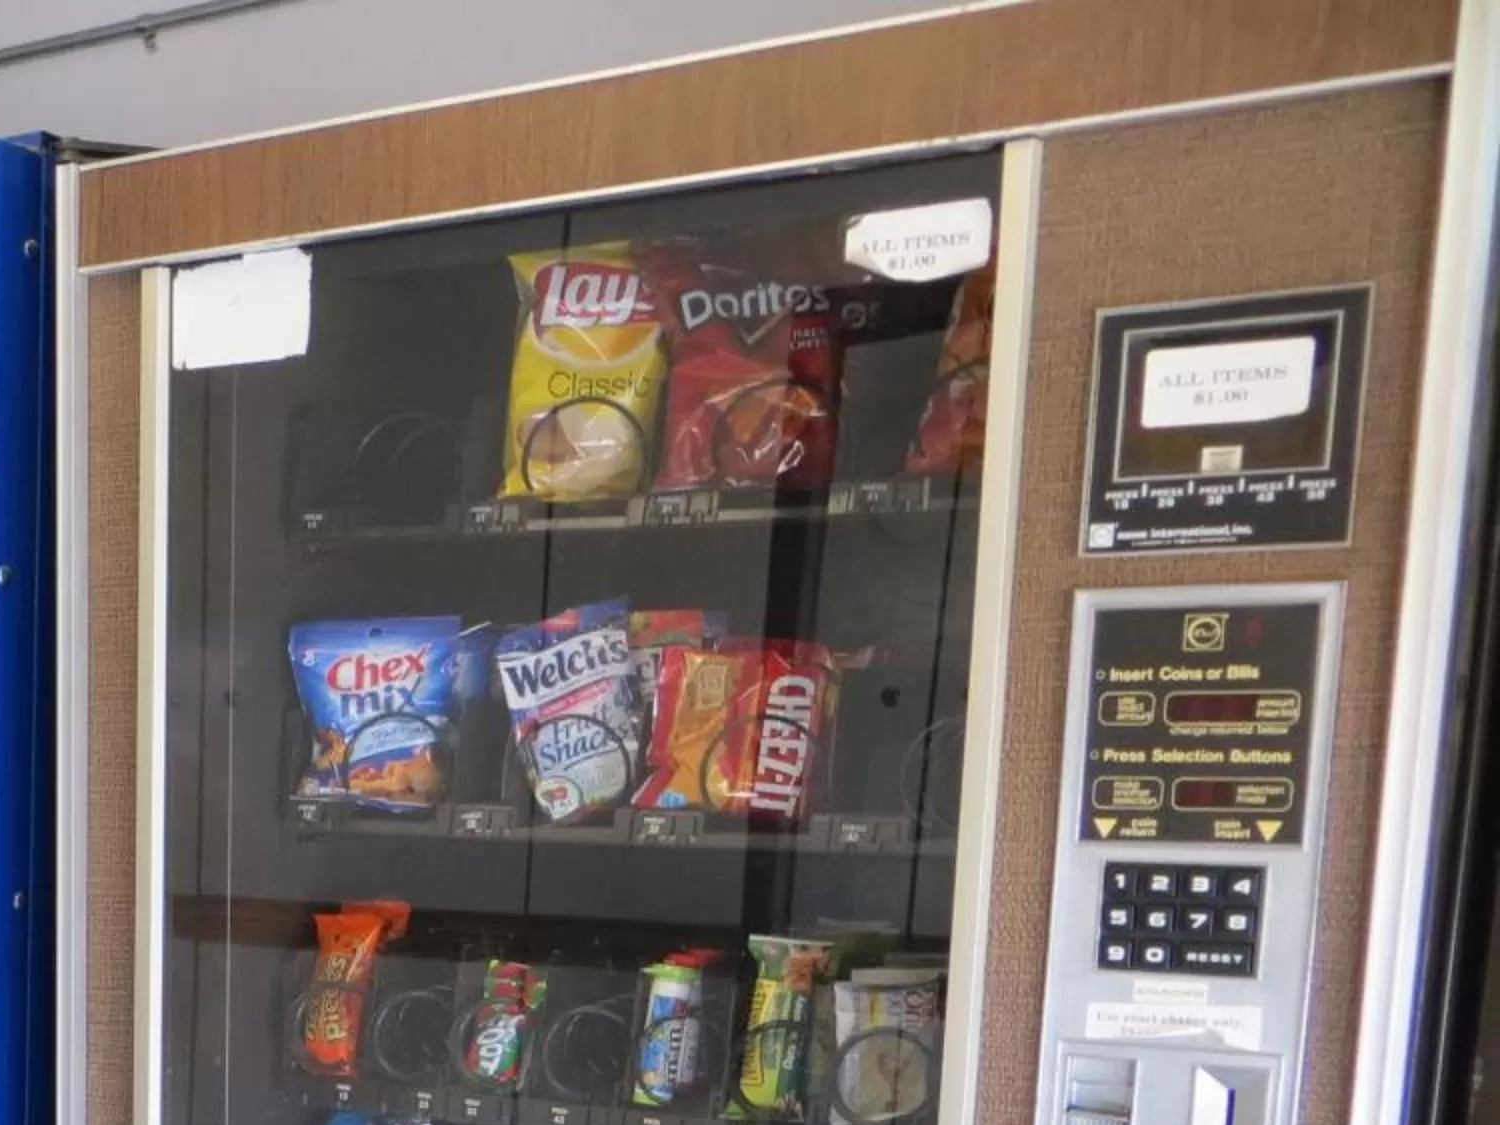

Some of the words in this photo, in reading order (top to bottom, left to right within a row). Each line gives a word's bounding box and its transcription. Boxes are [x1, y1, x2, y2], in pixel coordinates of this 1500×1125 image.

[680, 282, 831, 331] Doritos
[548, 372, 652, 400] Classic
[1158, 373, 1205, 389] ALL
[1211, 365, 1289, 385] ITEMS
[327, 643, 432, 693] Chex
[506, 632, 629, 699] Welch's
[1110, 667, 1155, 682] Insert
[1159, 666, 1203, 681] Coins
[1206, 668, 1223, 681] or
[1227, 664, 1260, 680] Bills
[1103, 748, 1146, 763] Press
[1152, 748, 1225, 763] Selection
[1229, 748, 1293, 763] Buttons
[1114, 873, 1126, 890] 1
[1151, 875, 1170, 892] 2
[1190, 876, 1210, 893] 3
[1232, 879, 1252, 895] 4
[1109, 909, 1127, 926] 5
[1148, 912, 1167, 928] 6
[1189, 913, 1208, 929] 7
[1227, 914, 1248, 931] 8
[1107, 945, 1125, 962] 9
[1186, 951, 1244, 966] RESET
